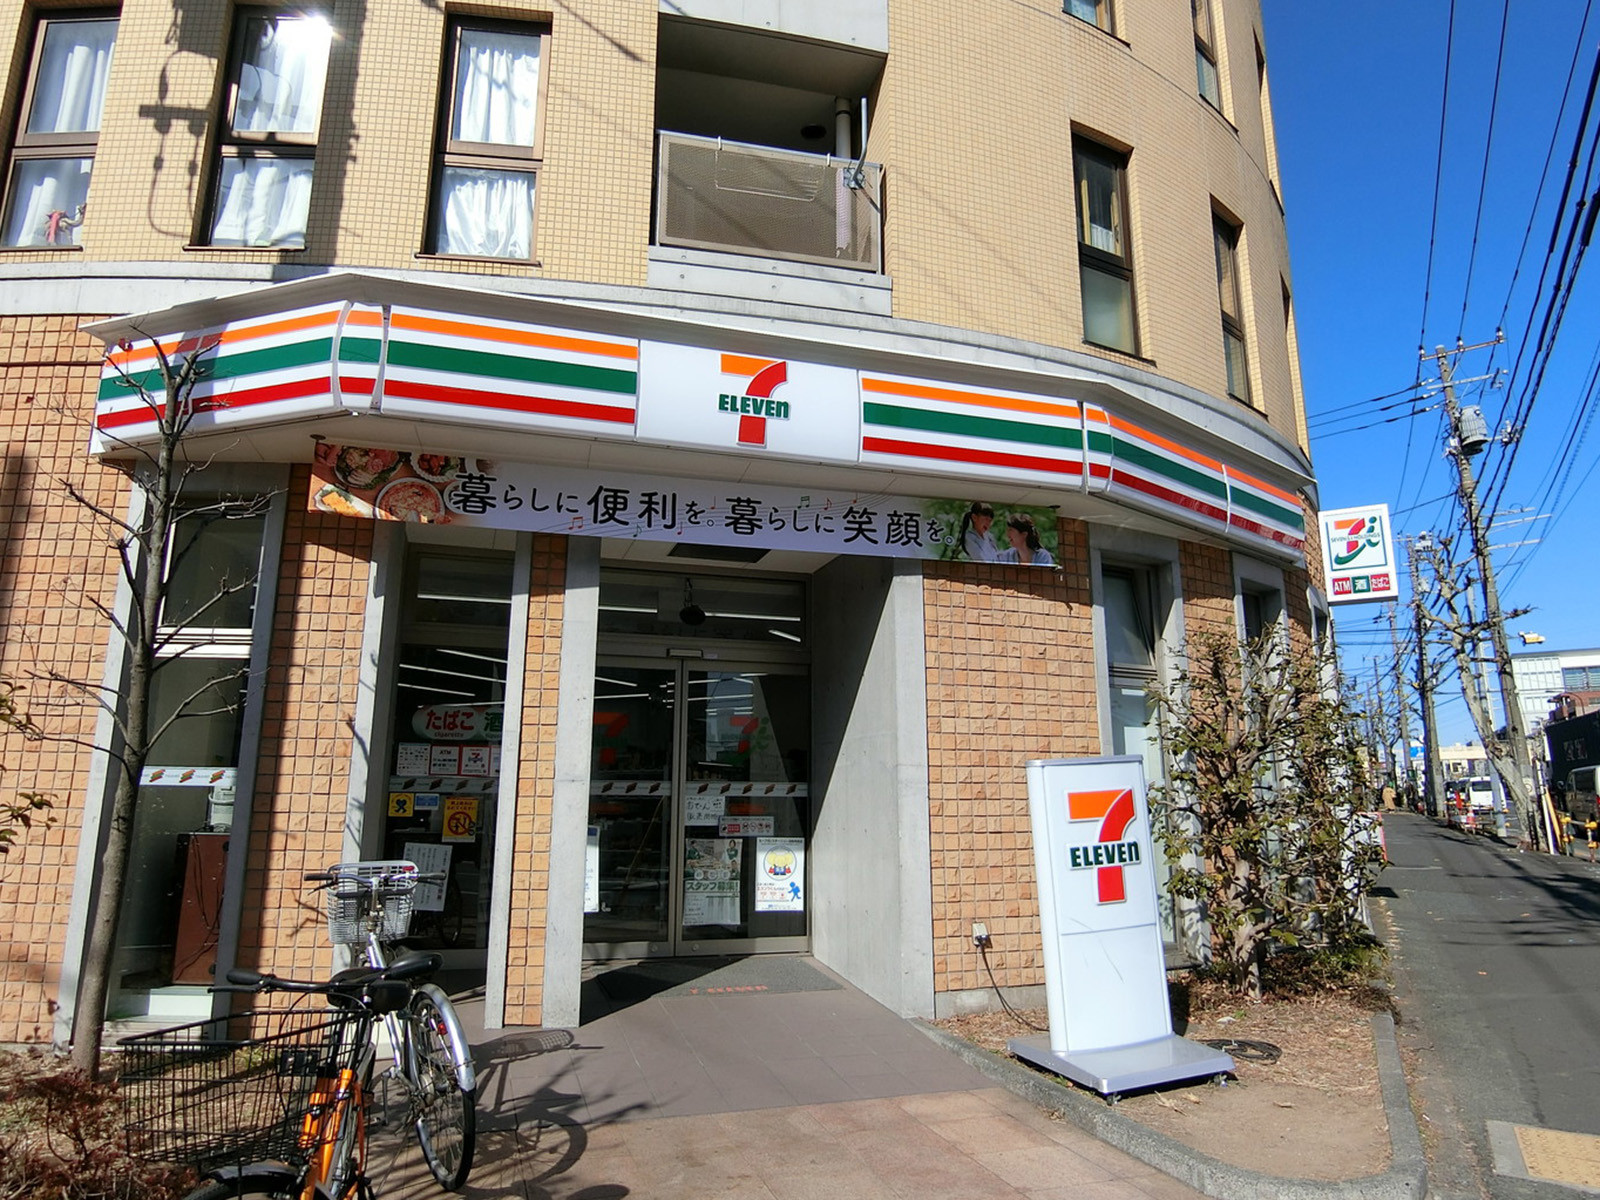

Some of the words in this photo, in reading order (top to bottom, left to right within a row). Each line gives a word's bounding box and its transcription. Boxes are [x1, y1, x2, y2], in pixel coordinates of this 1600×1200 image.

[1334, 580, 1351, 592] ATM
[1354, 578, 1367, 591] 酒
[1371, 577, 1390, 588] たばこ
[425, 709, 475, 731] たばこ
[484, 711, 502, 732] 酒
